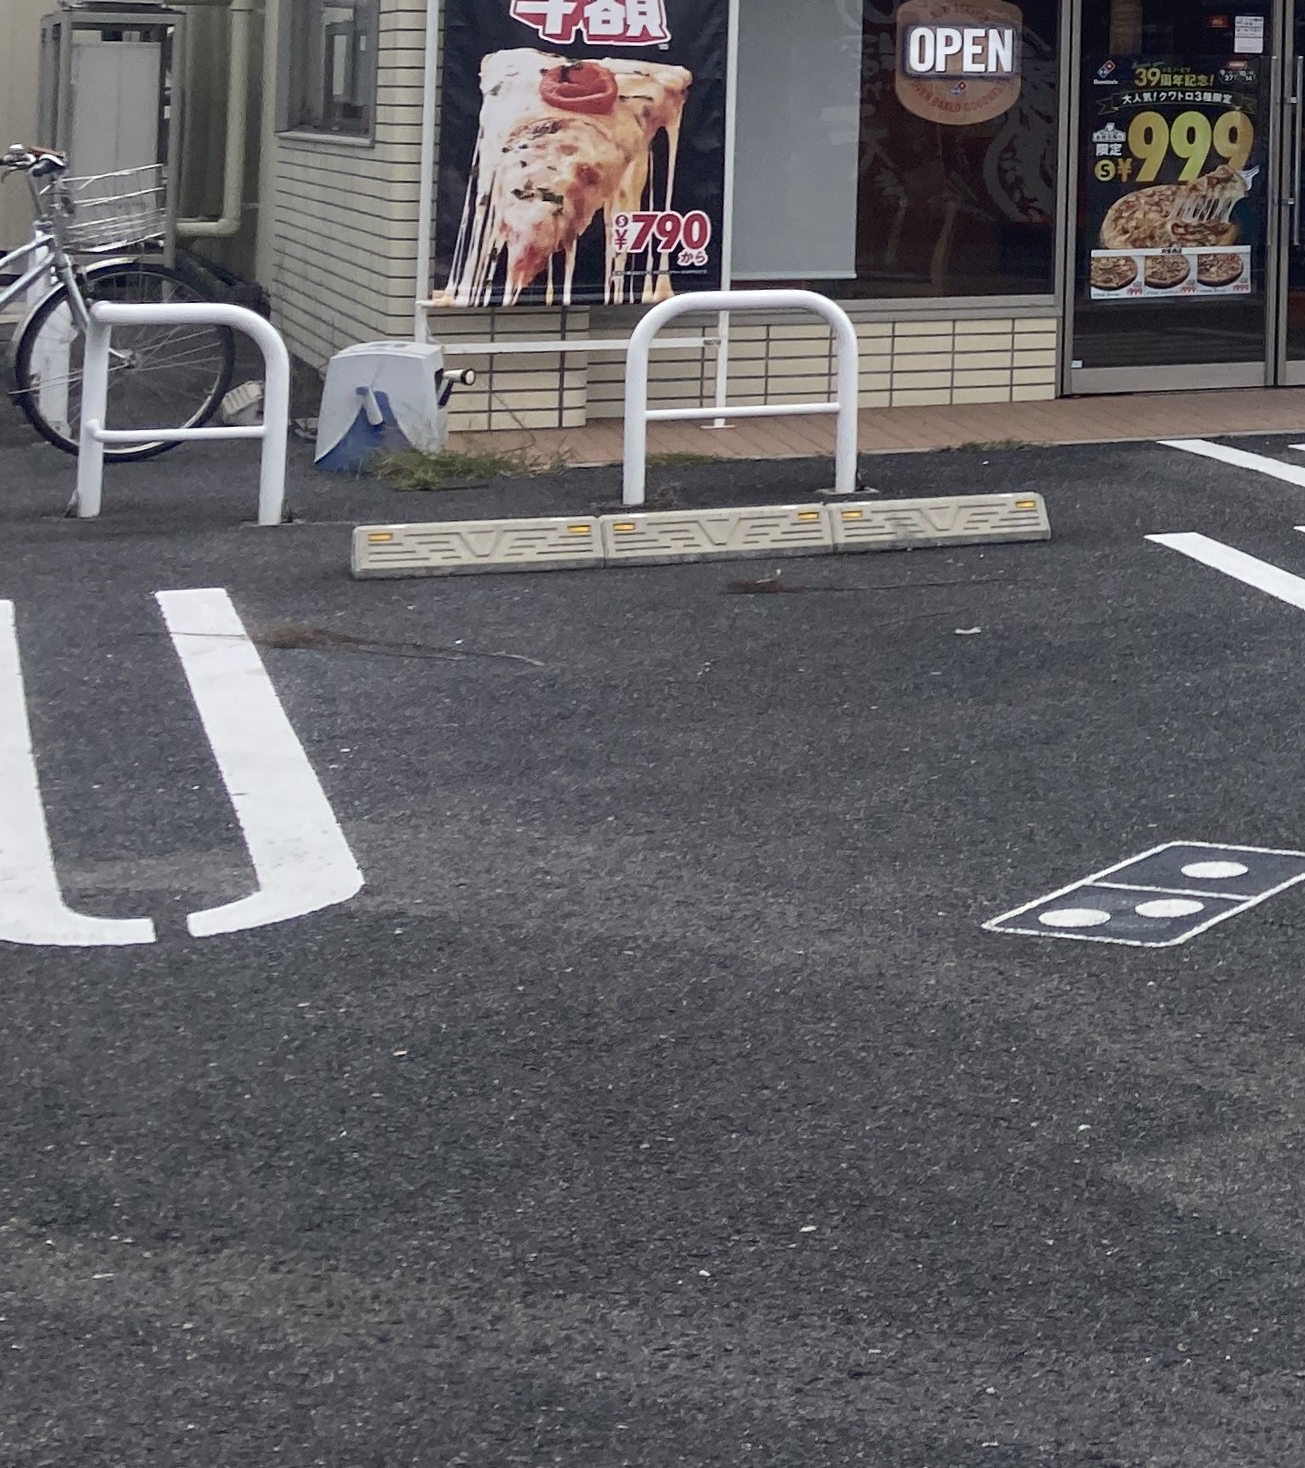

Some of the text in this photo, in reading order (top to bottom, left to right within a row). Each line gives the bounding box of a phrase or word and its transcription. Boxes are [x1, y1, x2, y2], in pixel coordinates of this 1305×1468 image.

[909, 26, 1013, 73] OPEN
[614, 212, 709, 251] ¥790
[680, 251, 707, 264] から
